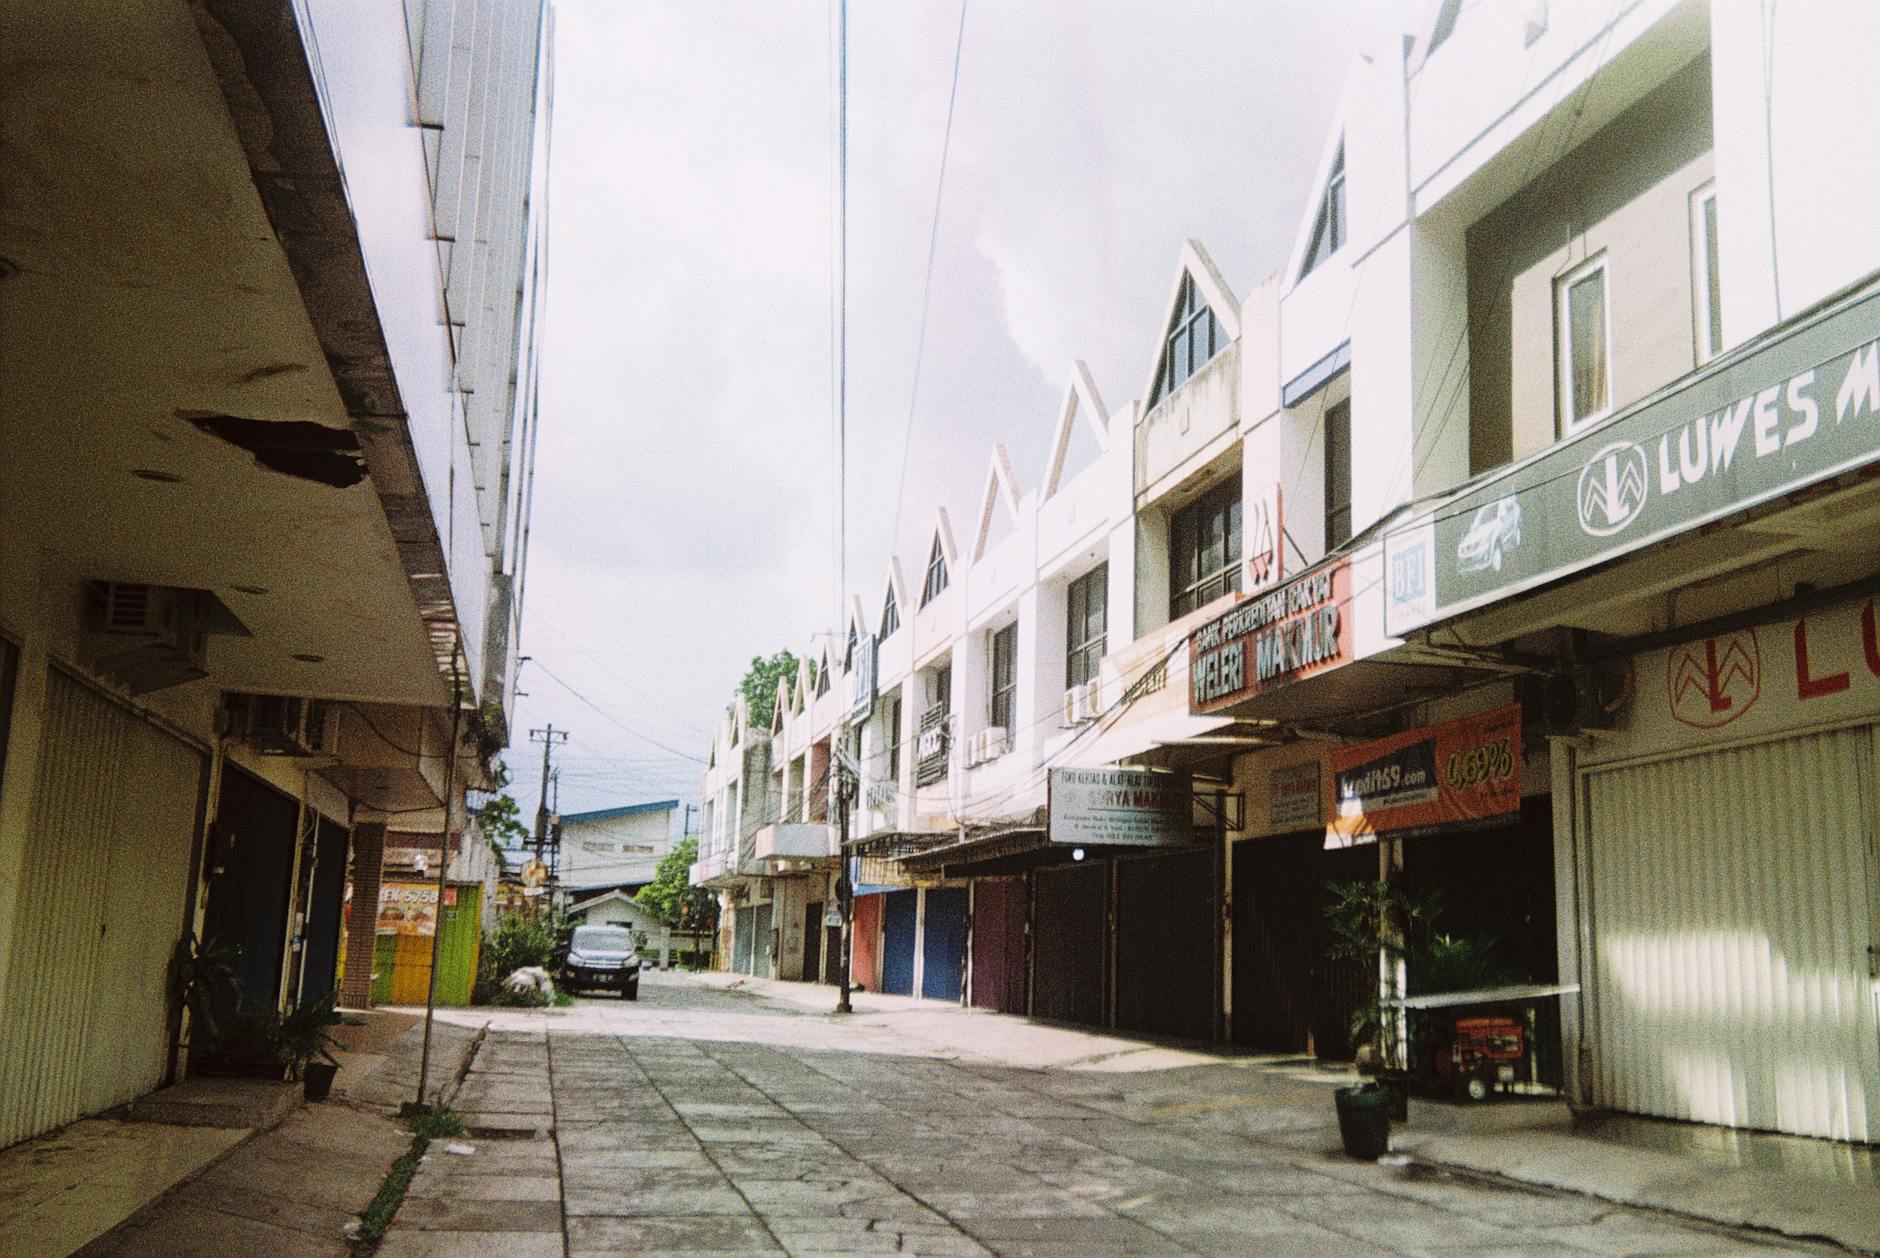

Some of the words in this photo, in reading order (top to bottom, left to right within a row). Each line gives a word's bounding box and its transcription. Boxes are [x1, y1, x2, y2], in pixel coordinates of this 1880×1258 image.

[1659, 369, 1819, 495] LUWES
[1194, 642, 1245, 704] WELERI
[1256, 604, 1339, 682] MAKMUR
